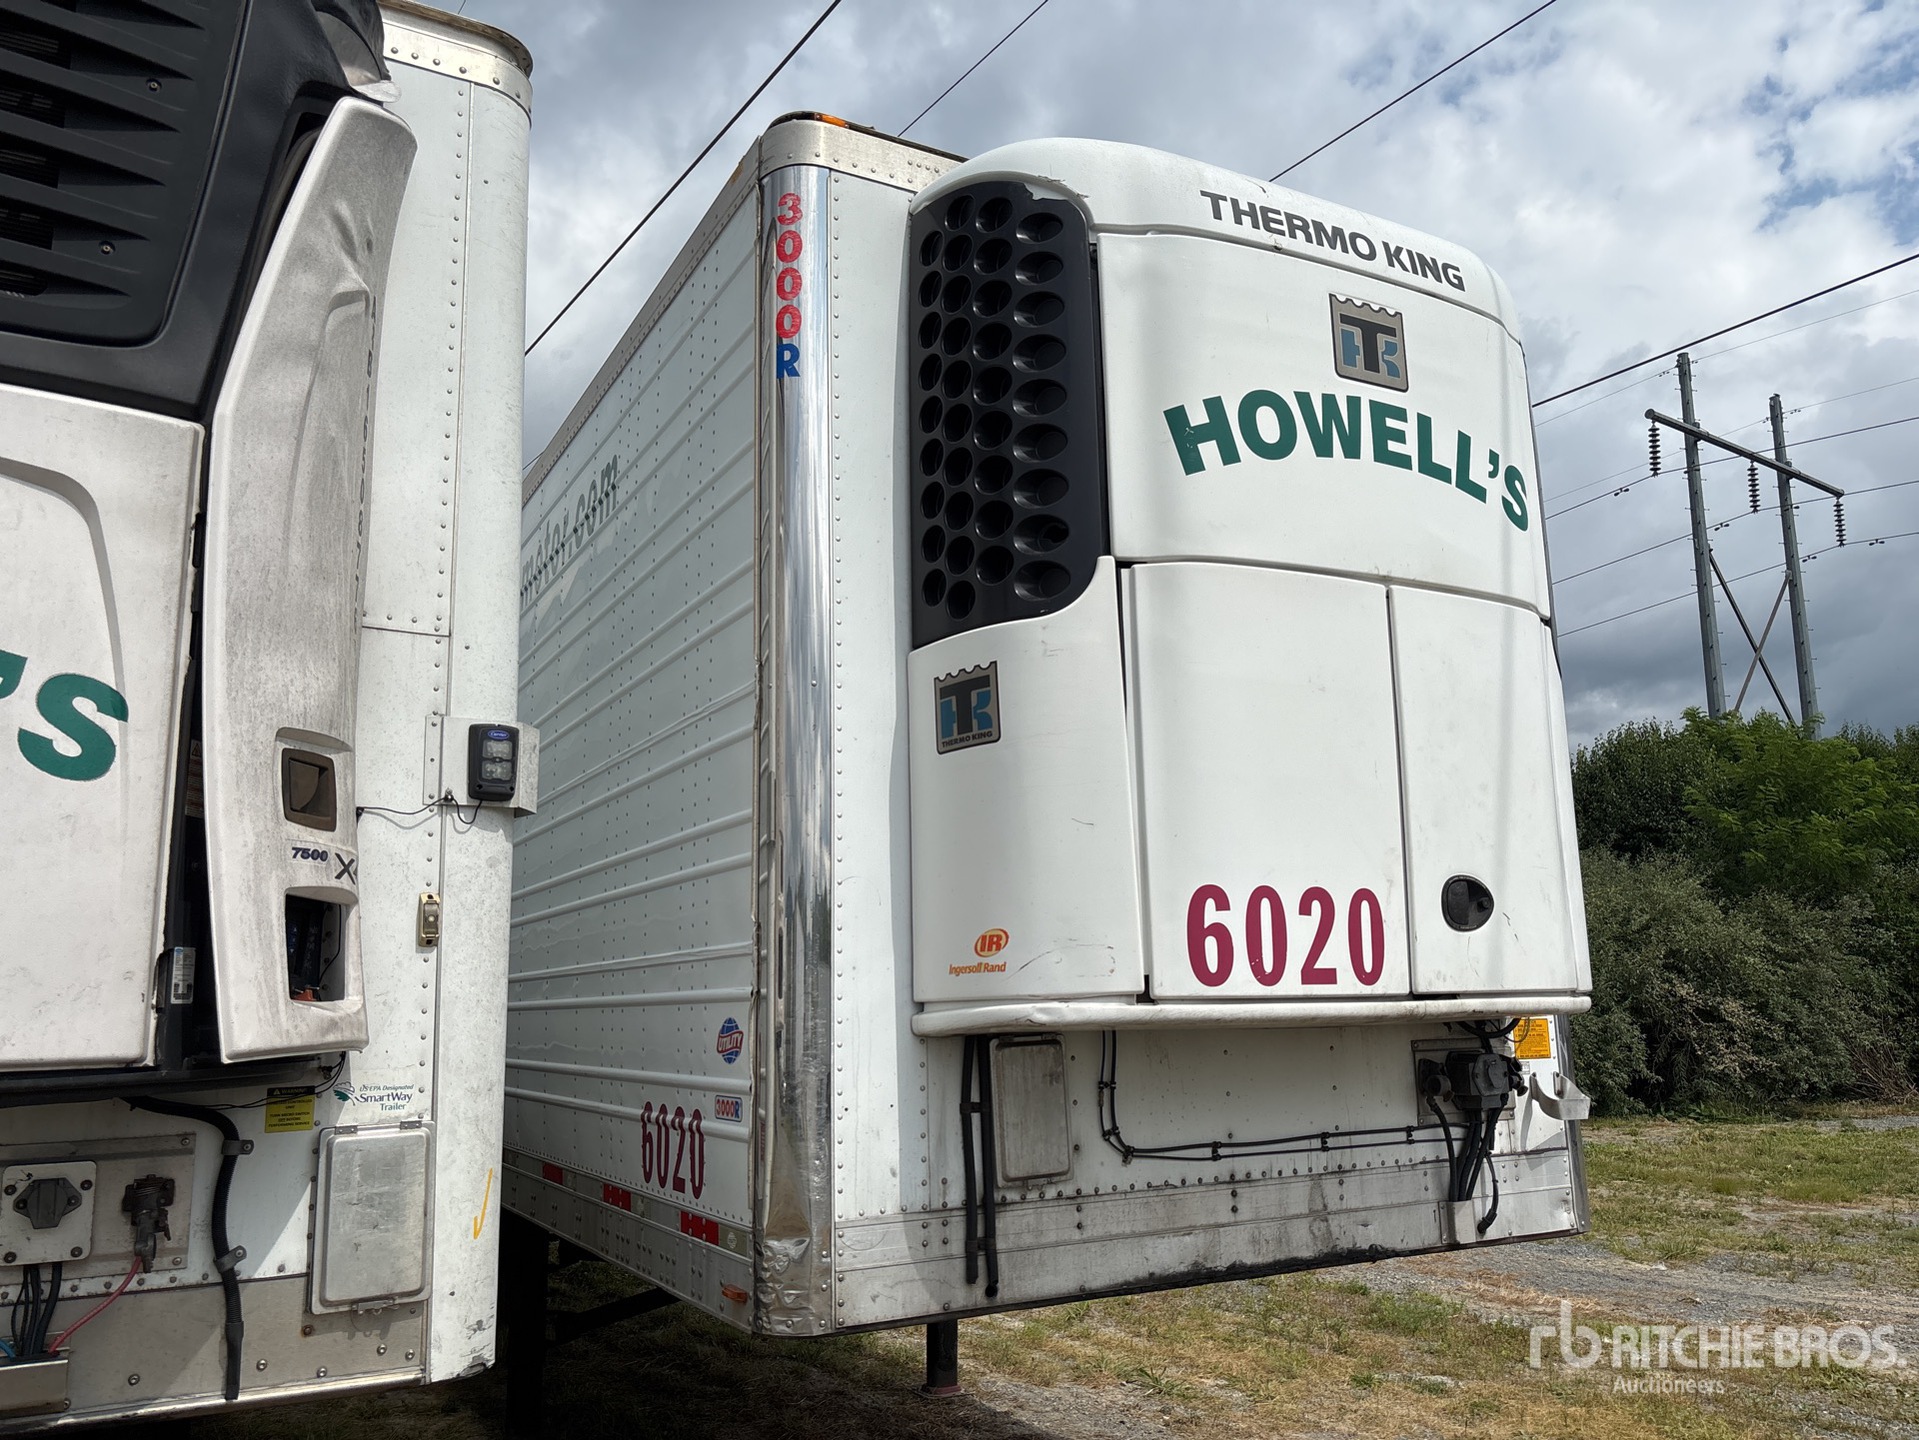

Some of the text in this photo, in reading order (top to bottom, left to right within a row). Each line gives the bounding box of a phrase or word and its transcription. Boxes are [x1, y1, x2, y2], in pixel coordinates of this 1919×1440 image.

[1200, 190, 1466, 292] THERMO KING
[1163, 389, 1529, 531] HOWELL'S
[942, 731, 993, 748] THERMO KING
[292, 847, 357, 885] 7500 X
[979, 934, 1003, 952] IR
[1187, 884, 1385, 987] 6020
[949, 962, 1007, 976] Ingersoll Rand
[718, 1032, 743, 1052] UTILITY
[359, 1092, 412, 1103] SmartWay
[380, 1103, 406, 1111] Trailer
[716, 1098, 740, 1119] 3000R
[641, 1101, 705, 1199] 6020
